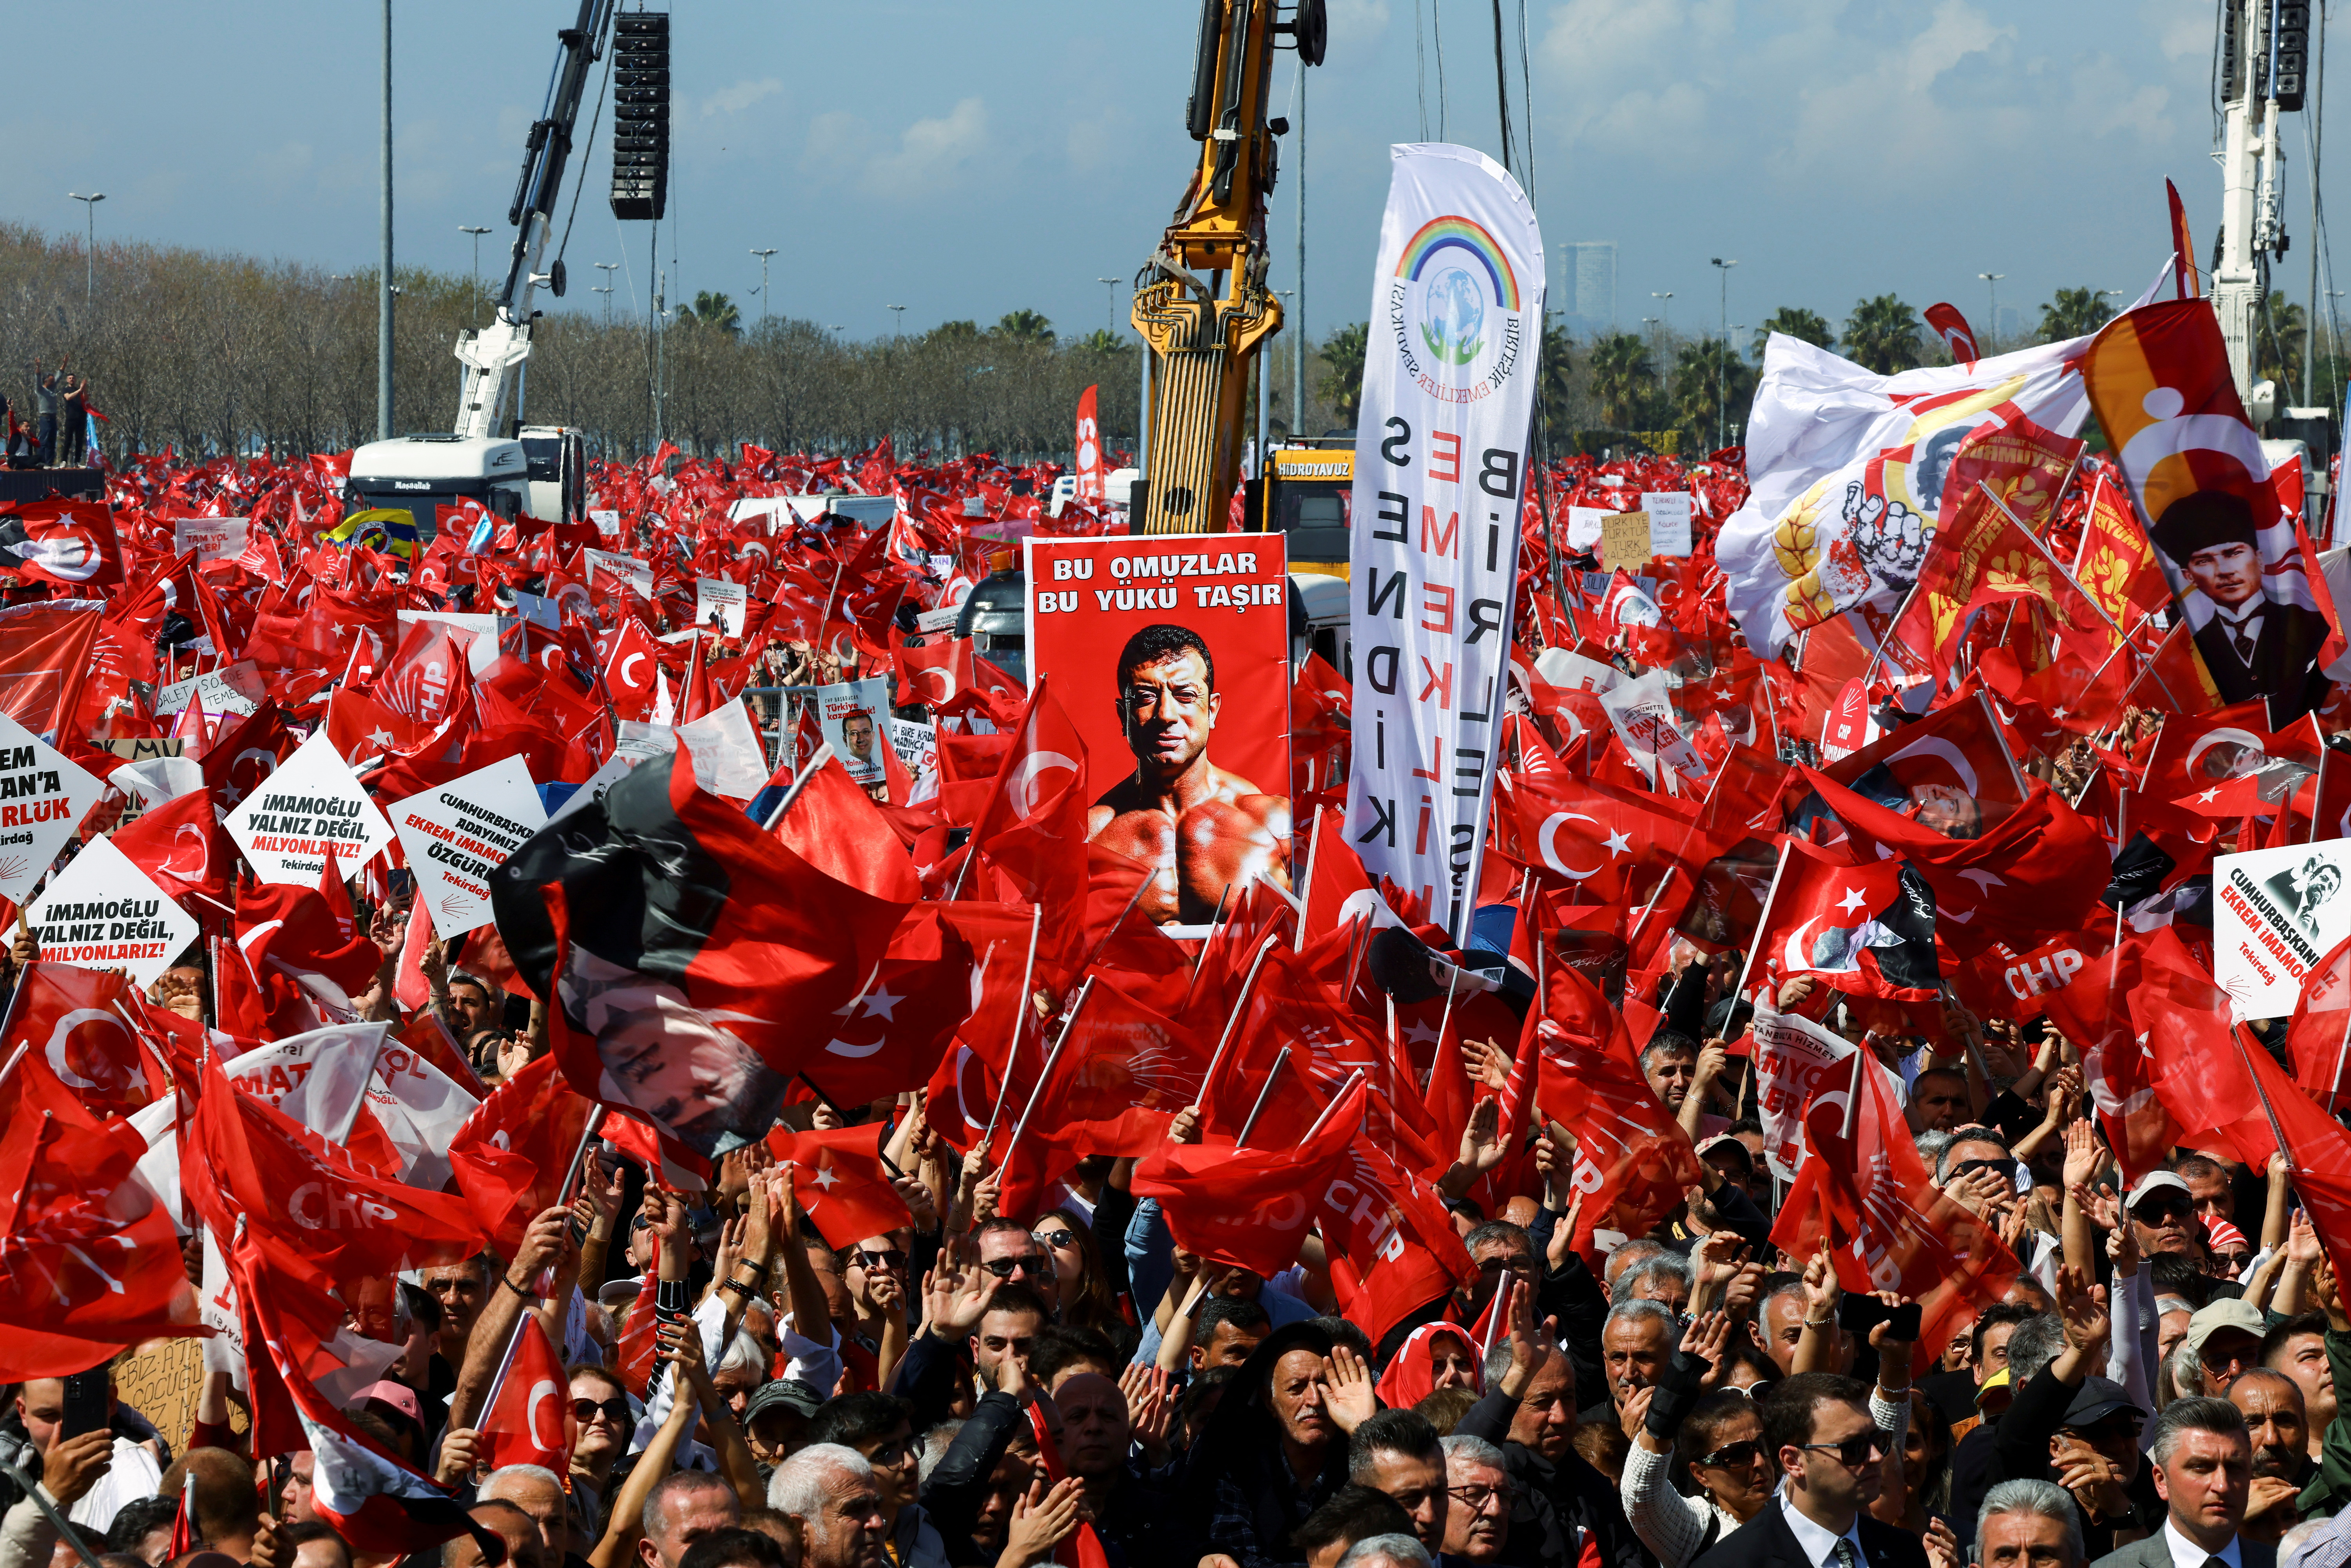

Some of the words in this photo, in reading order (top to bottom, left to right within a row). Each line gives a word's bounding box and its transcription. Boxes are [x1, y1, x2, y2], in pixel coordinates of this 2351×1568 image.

[186, 534, 208, 543] TAM
[210, 532, 229, 542] YOL
[602, 559, 622, 568] TAM
[1052, 558, 1093, 581] BU
[1110, 552, 1257, 579] OMUZLAR
[1038, 590, 1079, 614] BU
[1095, 578, 1178, 612] YÜKÜ
[1194, 584, 1282, 614] TAŞIR
[201, 669, 244, 691] SÖZDE
[205, 682, 247, 707] TEMELİ
[834, 695, 859, 703] BAŞARACAK
[825, 702, 859, 713] Türkiye
[827, 706, 876, 721] kazanacak!
[901, 726, 915, 738] BİRE
[1837, 723, 1852, 740] CHP
[262, 794, 362, 818] İMAMOĞLU
[248, 813, 312, 835] YALNIZ
[313, 818, 370, 843] DEĞİL,
[405, 813, 456, 843] EKREM
[455, 817, 520, 852] ADAYIMIZ
[251, 835, 361, 858] MİLYONLARIZ!
[281, 859, 324, 875] Tekirdağ
[442, 871, 491, 901] Tekirdağ
[45, 898, 159, 922] İMAMOĞLU
[2220, 884, 2263, 933] EKREM
[31, 923, 105, 943] YALNIZ
[109, 919, 174, 941] DEĞİL,
[40, 942, 166, 962] MİLYONLARIZ!
[2239, 941, 2277, 986] Tekirdağ
[2005, 949, 2083, 1000] CHP
[1779, 1155, 1793, 1166] CHP
[288, 1181, 398, 1230] CHP
[1323, 1179, 1405, 1263] CHP
